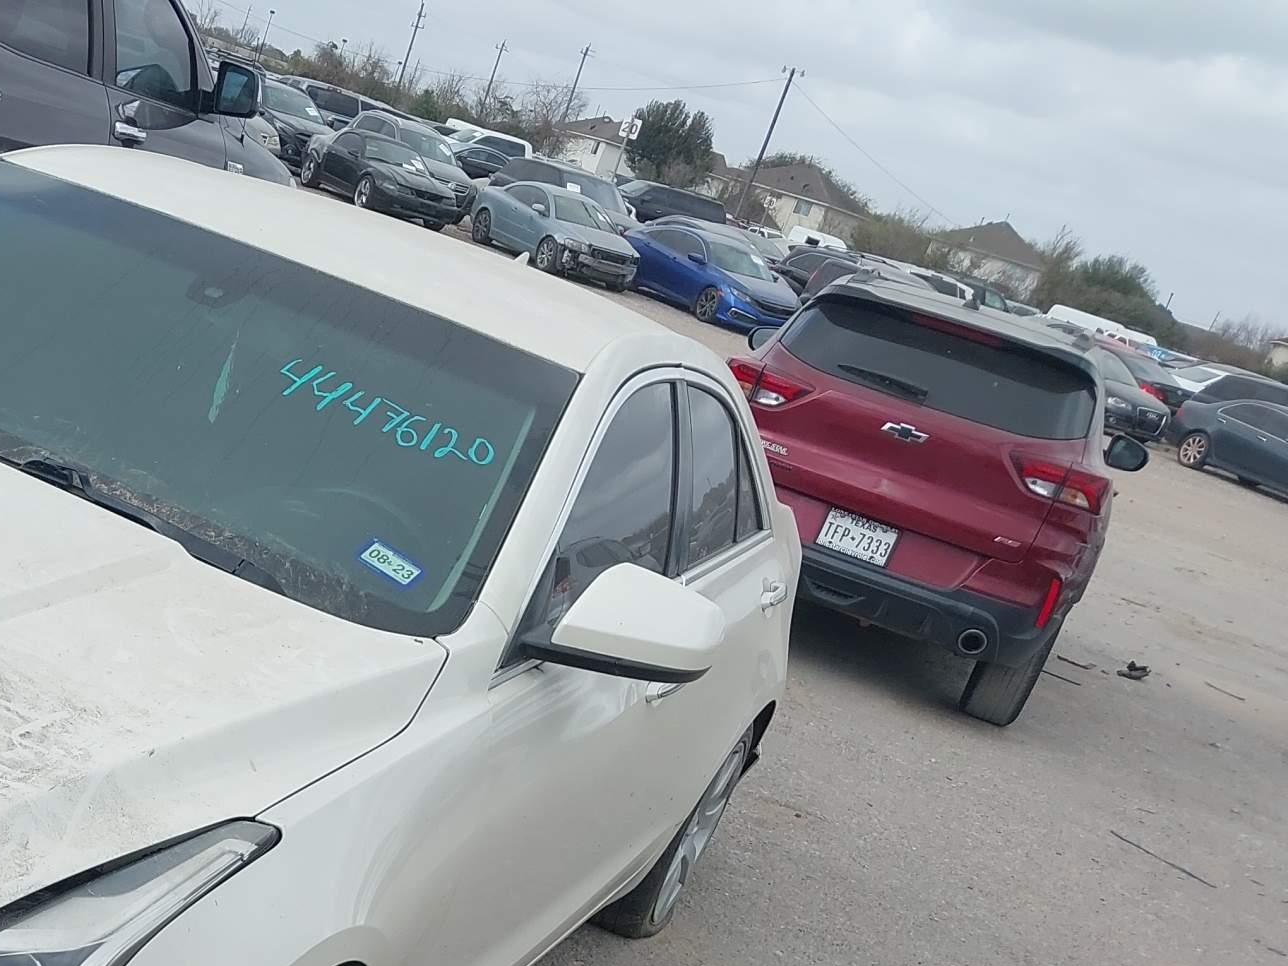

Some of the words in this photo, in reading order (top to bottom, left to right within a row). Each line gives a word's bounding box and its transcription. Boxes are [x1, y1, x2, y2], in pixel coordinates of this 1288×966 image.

[622, 121, 638, 135] 20
[280, 359, 495, 465] 44476120
[850, 518, 878, 533] TEXAS
